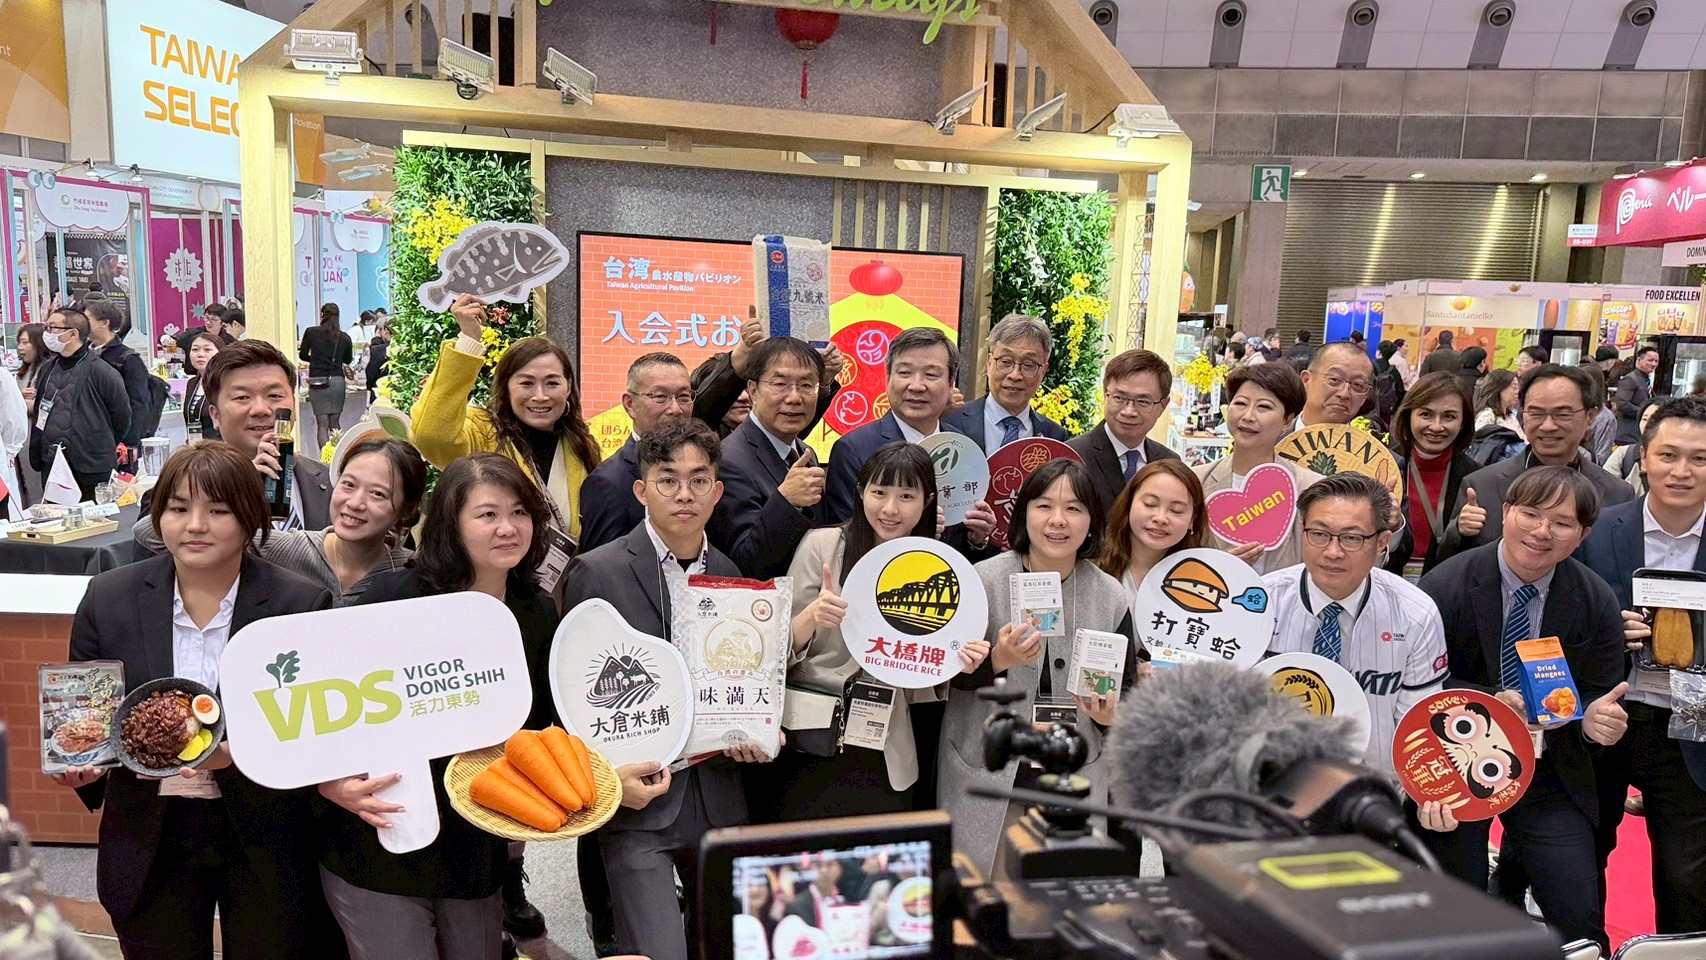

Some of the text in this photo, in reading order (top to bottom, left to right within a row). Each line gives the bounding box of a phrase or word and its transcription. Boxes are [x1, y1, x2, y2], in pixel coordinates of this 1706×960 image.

[323, 271, 343, 284] UAN
[603, 255, 650, 281] 台湾
[606, 280, 694, 293] Taiwan Agricultural Pavilion
[1645, 289, 1665, 300] FOOD
[602, 310, 742, 347] 入会式お
[1277, 427, 1382, 466] AIWAN
[1221, 490, 1286, 532] Taiwan
[1151, 610, 1241, 661] 打寶蛤
[865, 636, 946, 667] 大橋牌
[864, 655, 943, 677] BIG BRIDGE RICE
[1534, 670, 1566, 679] Mangoes
[1536, 663, 1557, 672] Dried
[406, 667, 506, 698] DONG SHIH
[252, 658, 465, 743] VDS VIGOR
[409, 691, 480, 717] 活力東勢
[589, 705, 670, 738] 大倉米鋪
[603, 734, 625, 743] OKURA
[643, 727, 661, 736] SHOP
[1412, 755, 1453, 788] 冠軍
